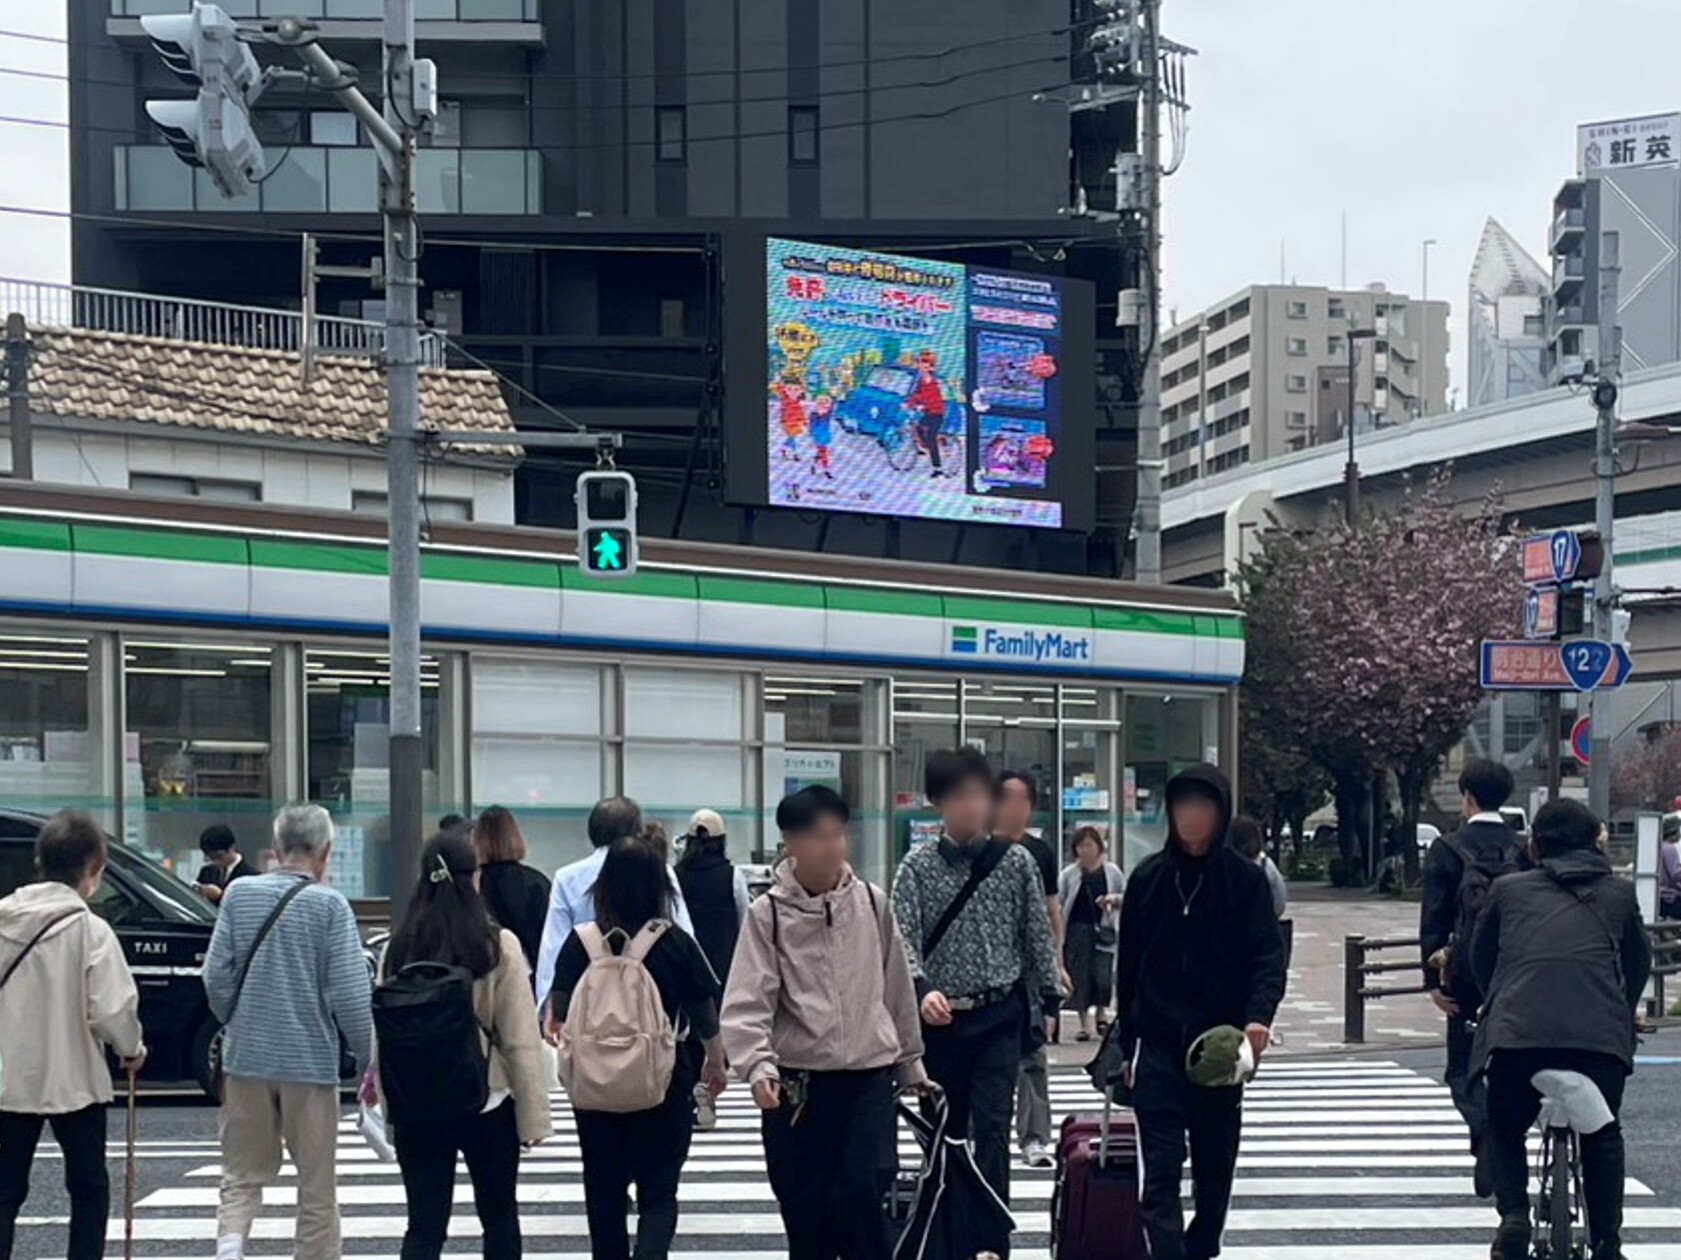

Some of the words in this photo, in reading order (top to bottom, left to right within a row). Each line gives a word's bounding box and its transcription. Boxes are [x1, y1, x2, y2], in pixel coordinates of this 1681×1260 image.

[1609, 134, 1672, 164] 新英
[984, 628, 1089, 661] FamilyMart
[1567, 646, 1604, 672] 122
[134, 942, 167, 953] TAXI
